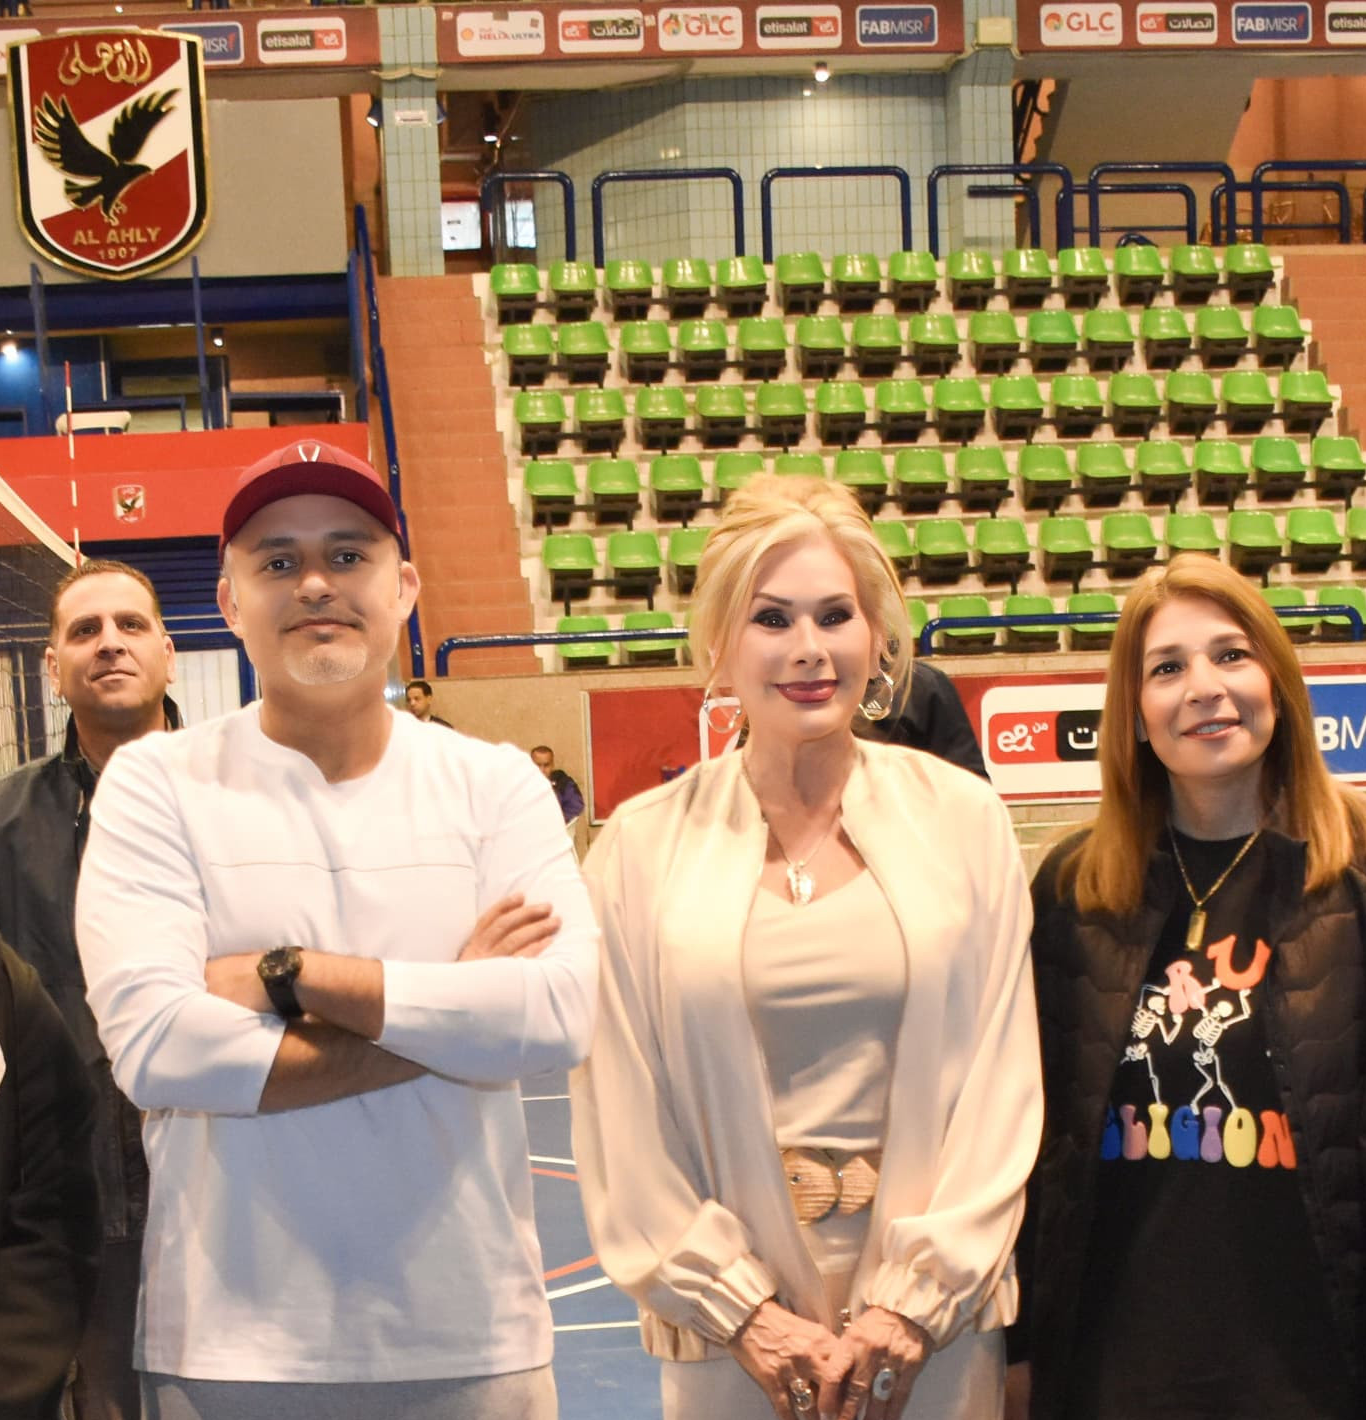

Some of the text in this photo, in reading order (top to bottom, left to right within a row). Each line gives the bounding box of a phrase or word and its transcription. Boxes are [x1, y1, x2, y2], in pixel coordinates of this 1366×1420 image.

[763, 21, 808, 34] etisalat
[861, 20, 924, 35] FABMISR
[1066, 11, 1115, 32] GLC
[1236, 16, 1299, 32] FABMISR
[265, 35, 311, 48] etisalat
[73, 226, 161, 246] AL AHLY
[98, 248, 138, 260] 1907
